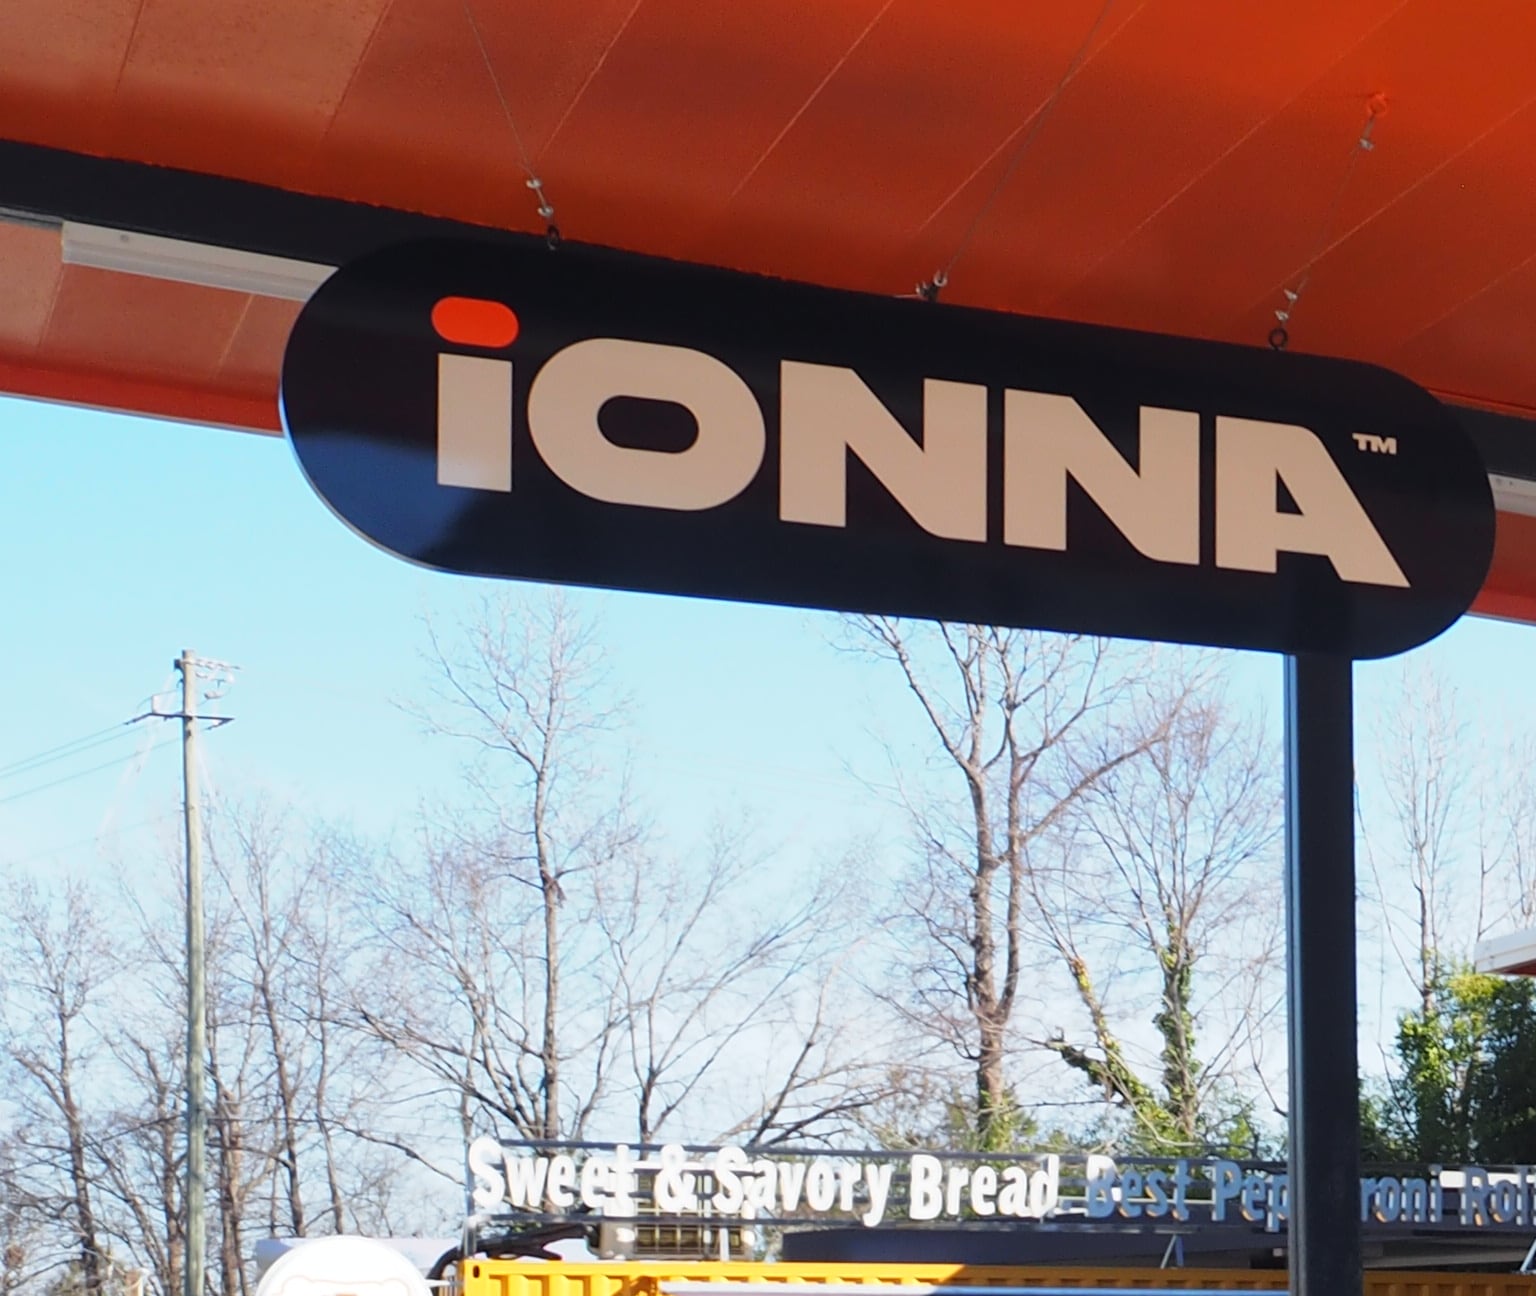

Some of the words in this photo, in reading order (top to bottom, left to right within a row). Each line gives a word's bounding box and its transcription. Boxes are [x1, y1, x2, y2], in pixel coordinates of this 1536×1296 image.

[469, 1136, 636, 1211] Sweet
[654, 1143, 697, 1213] &
[713, 1146, 893, 1228] Savory
[1085, 1155, 1190, 1221] Best
[1212, 1160, 1443, 1233] Peproni
